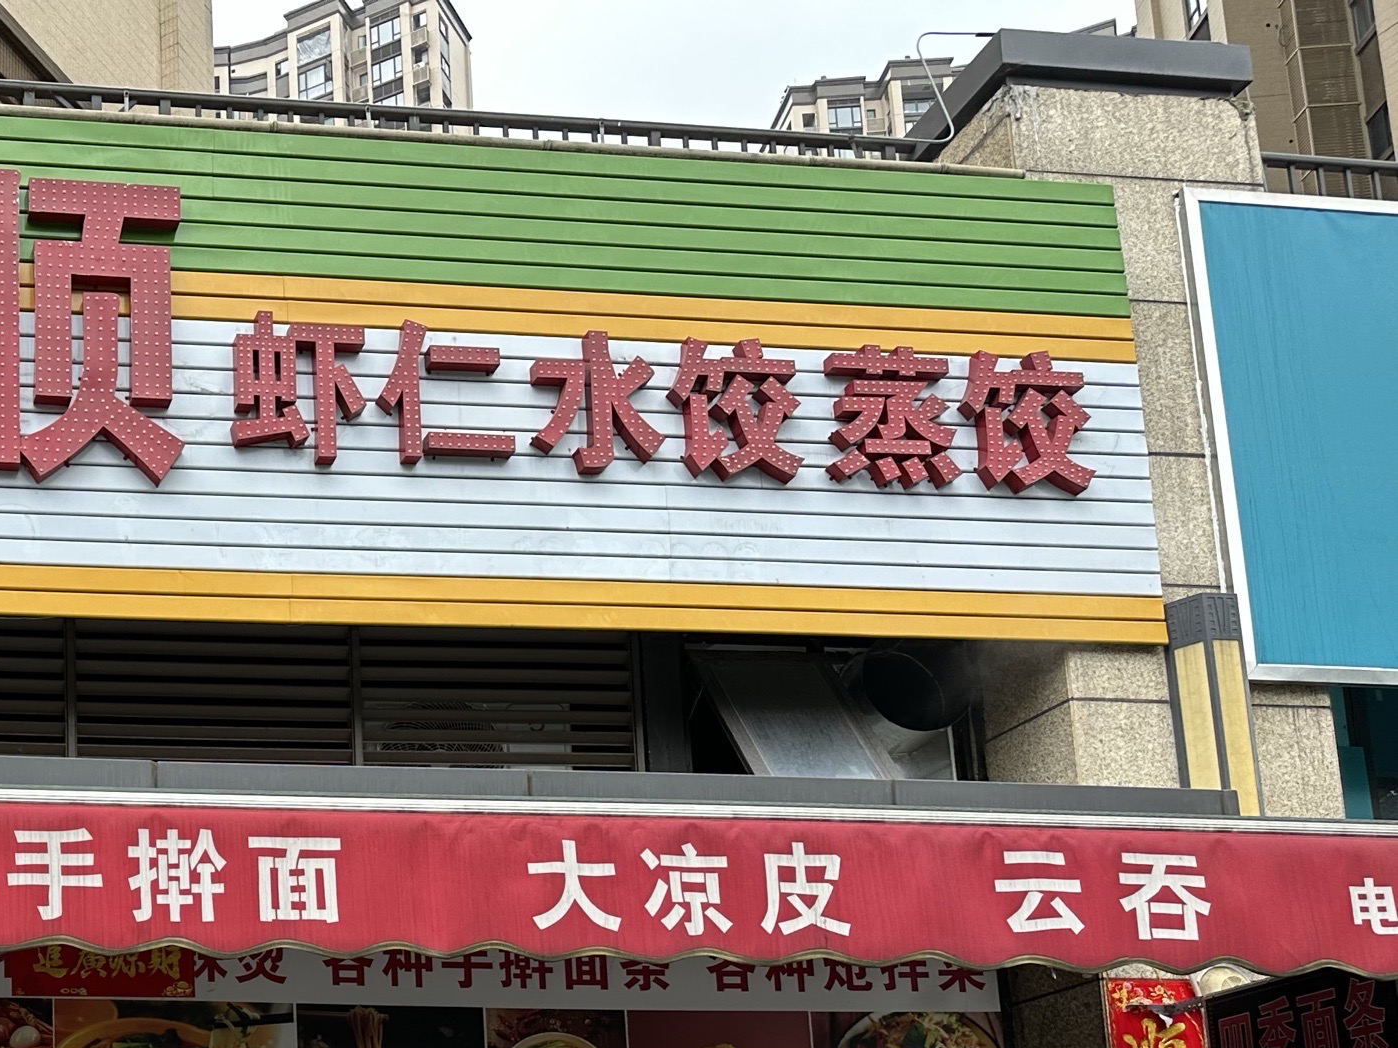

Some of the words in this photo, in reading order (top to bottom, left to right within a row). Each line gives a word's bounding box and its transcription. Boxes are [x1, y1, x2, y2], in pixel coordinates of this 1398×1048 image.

[230, 310, 1096, 496] 虾仁水饺蒸饺
[7, 828, 341, 923] 手擀面
[527, 839, 851, 936] 大凉皮
[994, 851, 1211, 941] 云吞
[1349, 877, 1398, 935] 电
